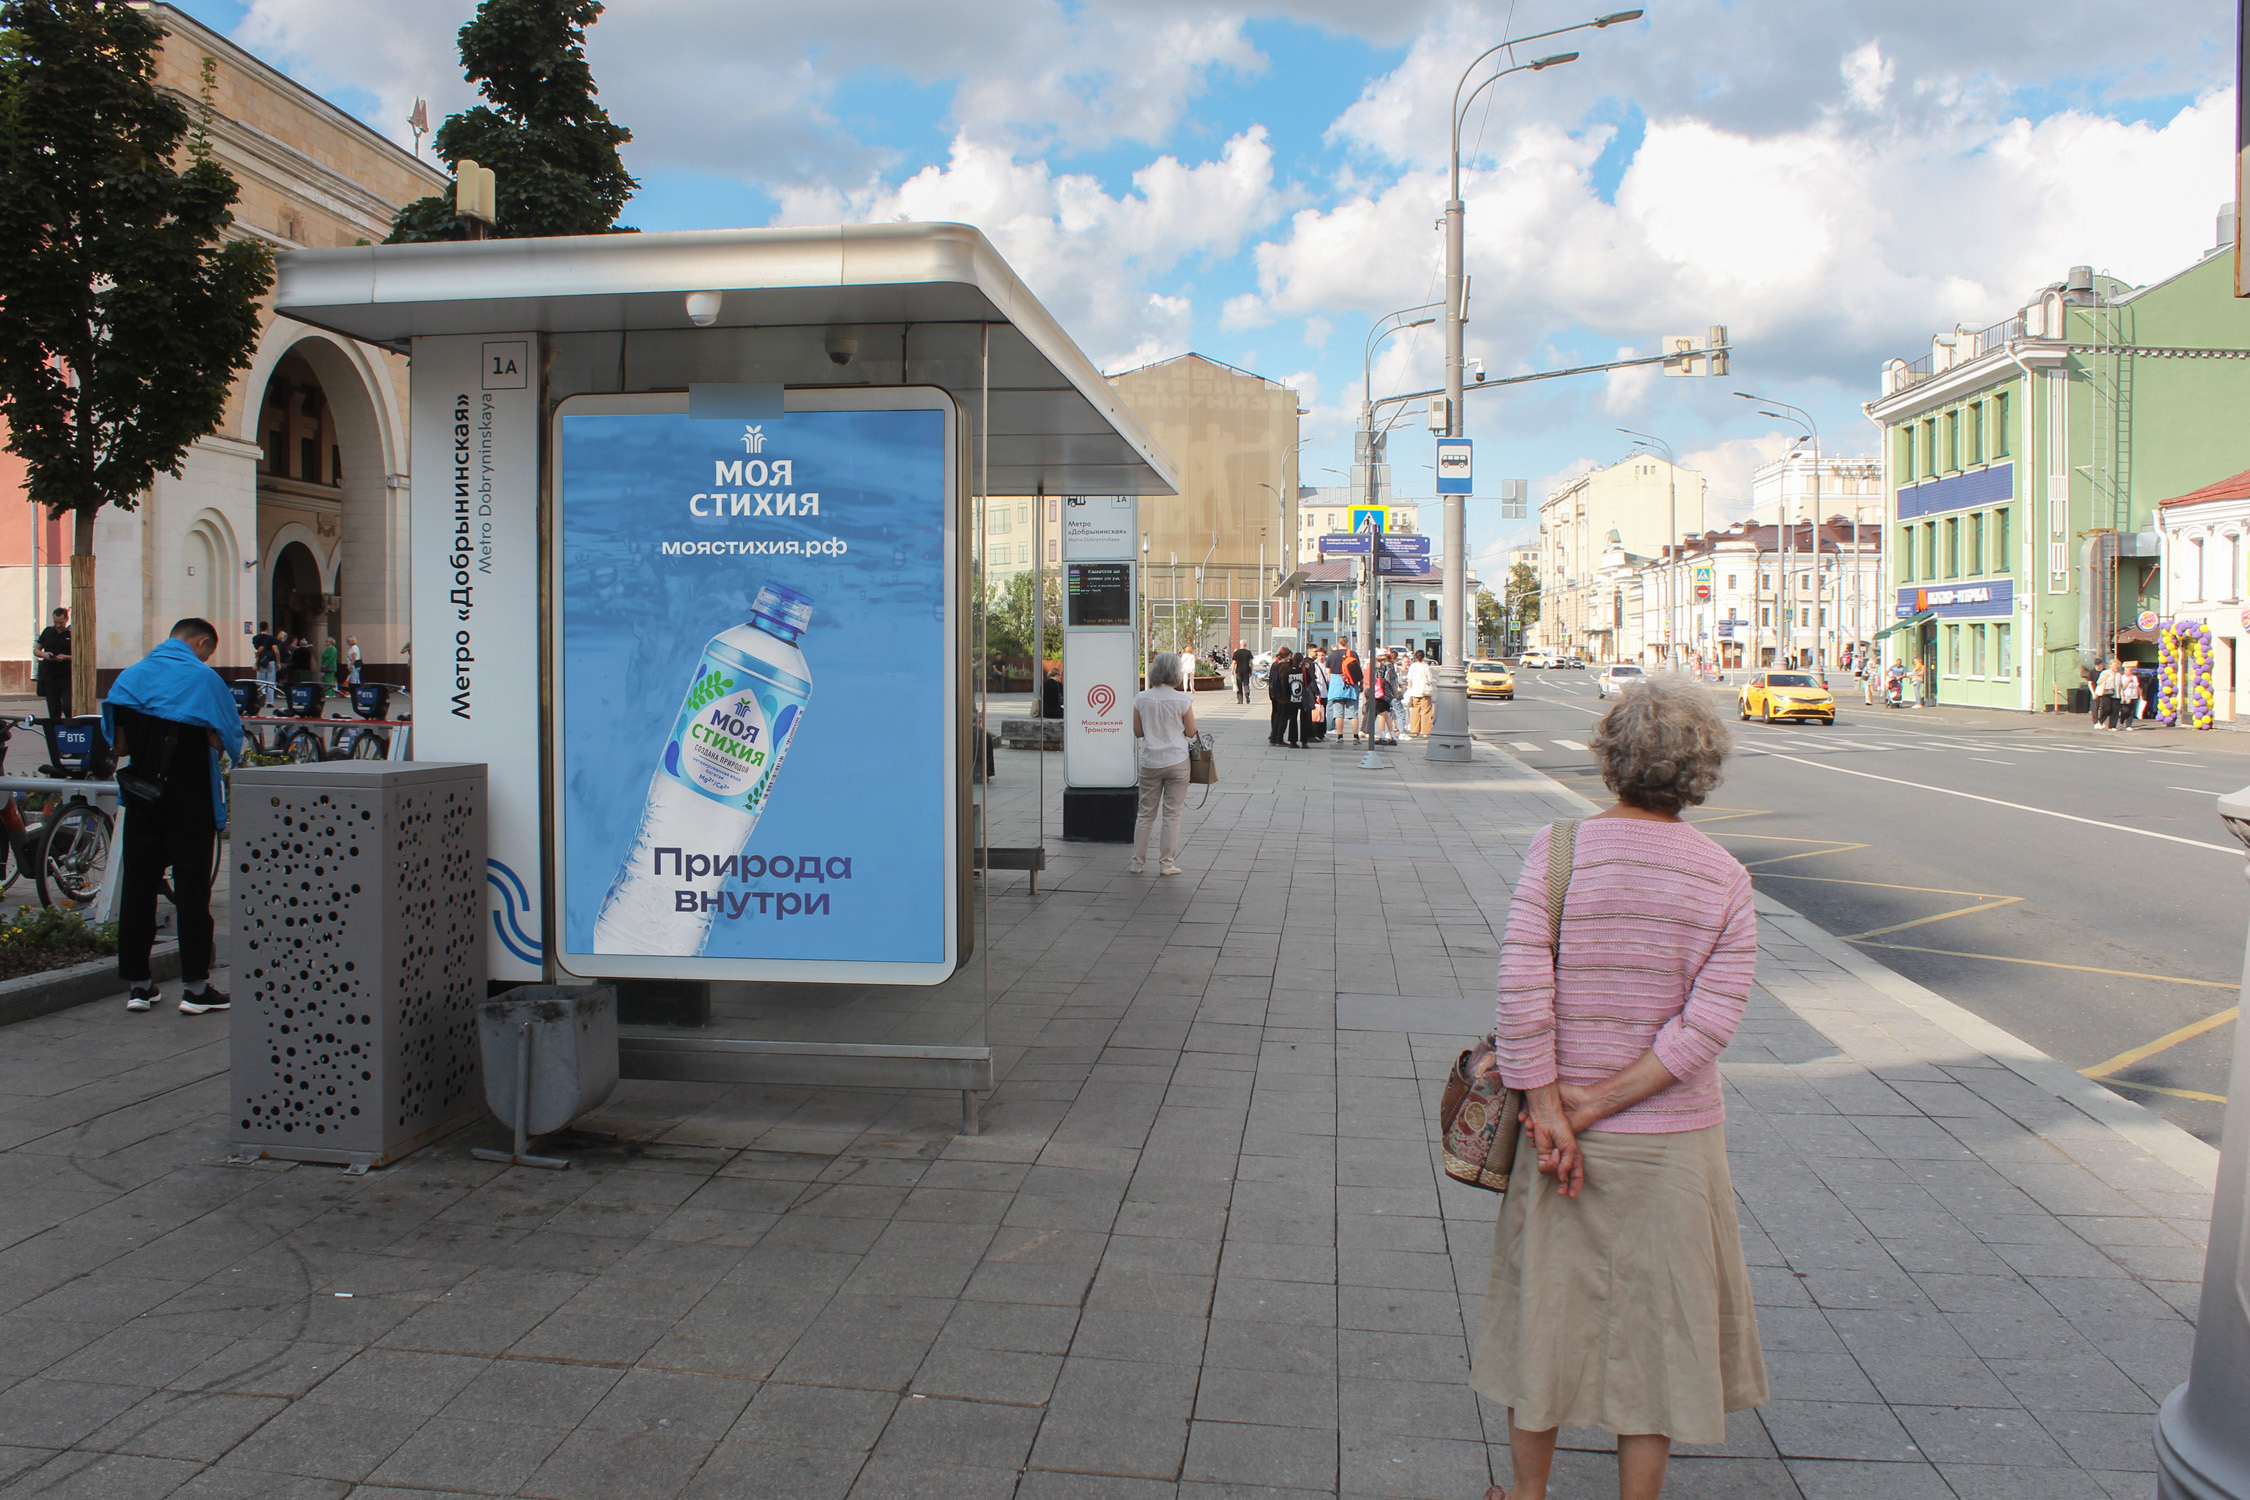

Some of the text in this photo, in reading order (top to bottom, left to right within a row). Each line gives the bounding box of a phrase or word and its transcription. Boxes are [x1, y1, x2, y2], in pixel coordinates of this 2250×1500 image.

[478, 393, 495, 574] Metro Dobryninskaya
[715, 460, 792, 486] МОЯ
[689, 493, 819, 517] СТИХИЯ
[450, 393, 474, 720] Метро «Добрынинская»
[661, 536, 848, 558] моястихия.рф
[67, 733, 86, 743] ВТБ
[710, 709, 760, 744] МОЯ
[1084, 726, 1121, 734] Транспорт
[691, 723, 766, 767] СТИХИЯ
[694, 744, 750, 774] СОЗДАНА ПРИРОДОЙ
[654, 847, 852, 884] Природа
[675, 890, 830, 920] внутри
